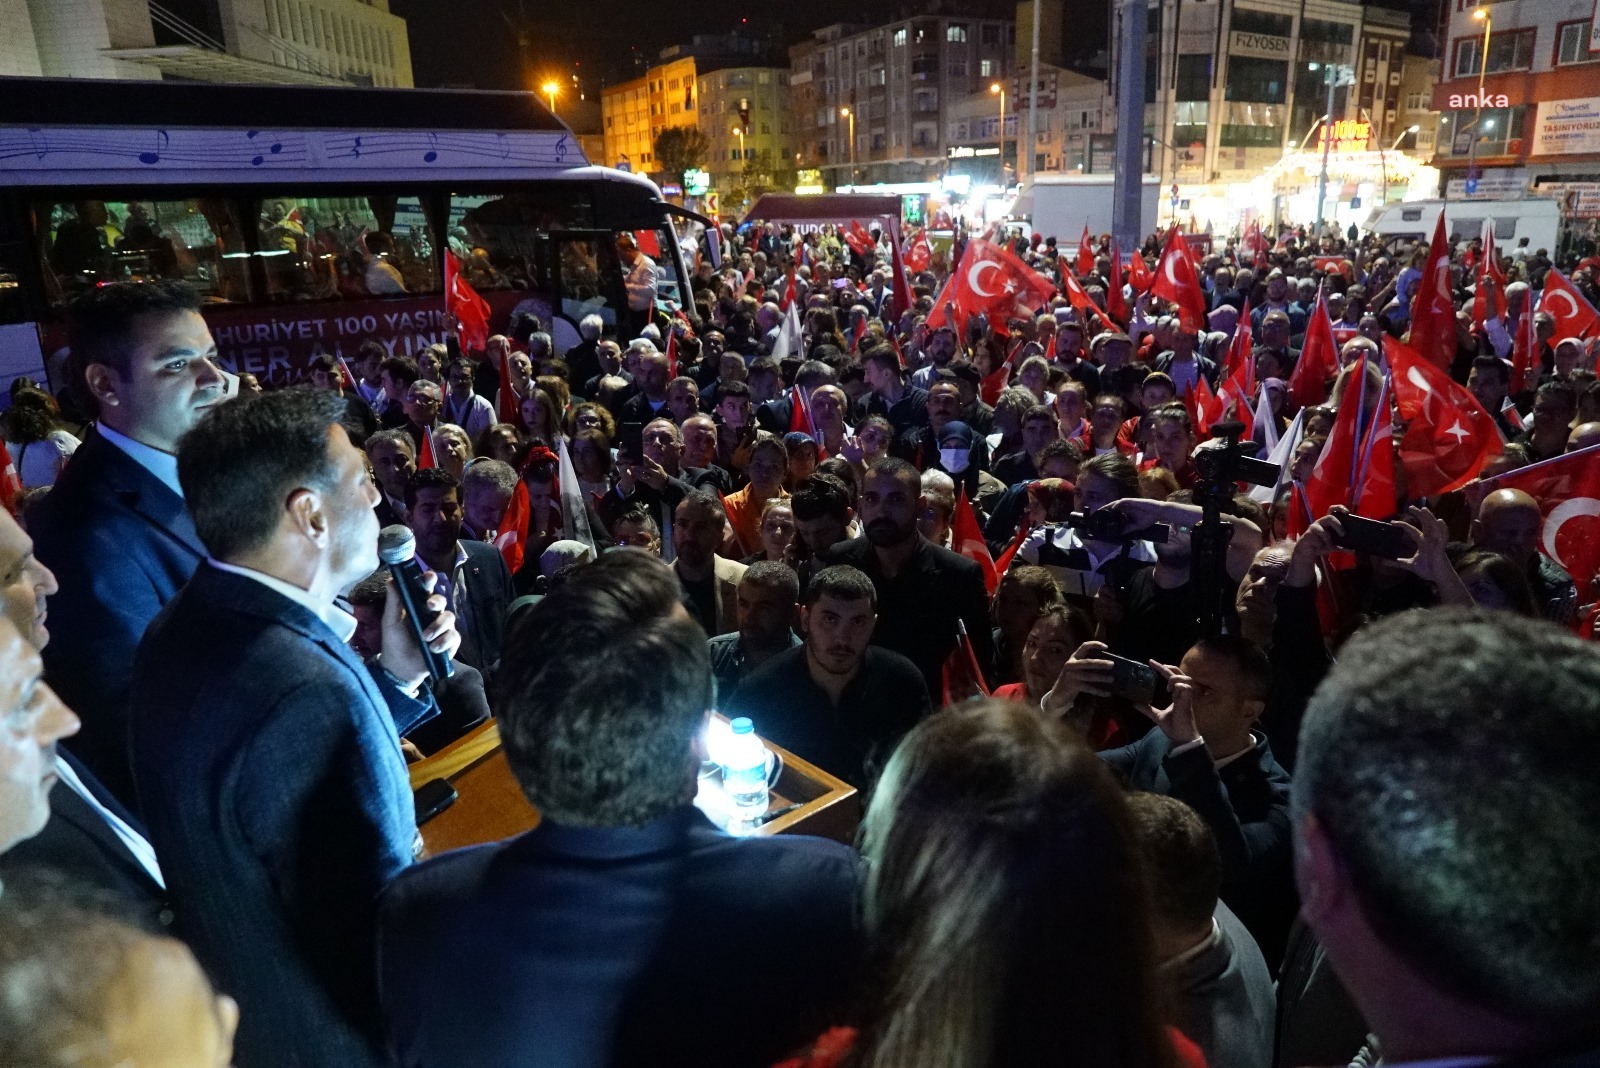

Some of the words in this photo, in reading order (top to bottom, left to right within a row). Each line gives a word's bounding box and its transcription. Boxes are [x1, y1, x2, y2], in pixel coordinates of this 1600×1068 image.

[212, 317, 327, 347] HURİYET
[333, 314, 377, 336] 100
[384, 309, 456, 332] YAŞIN
[215, 344, 292, 374] NER
